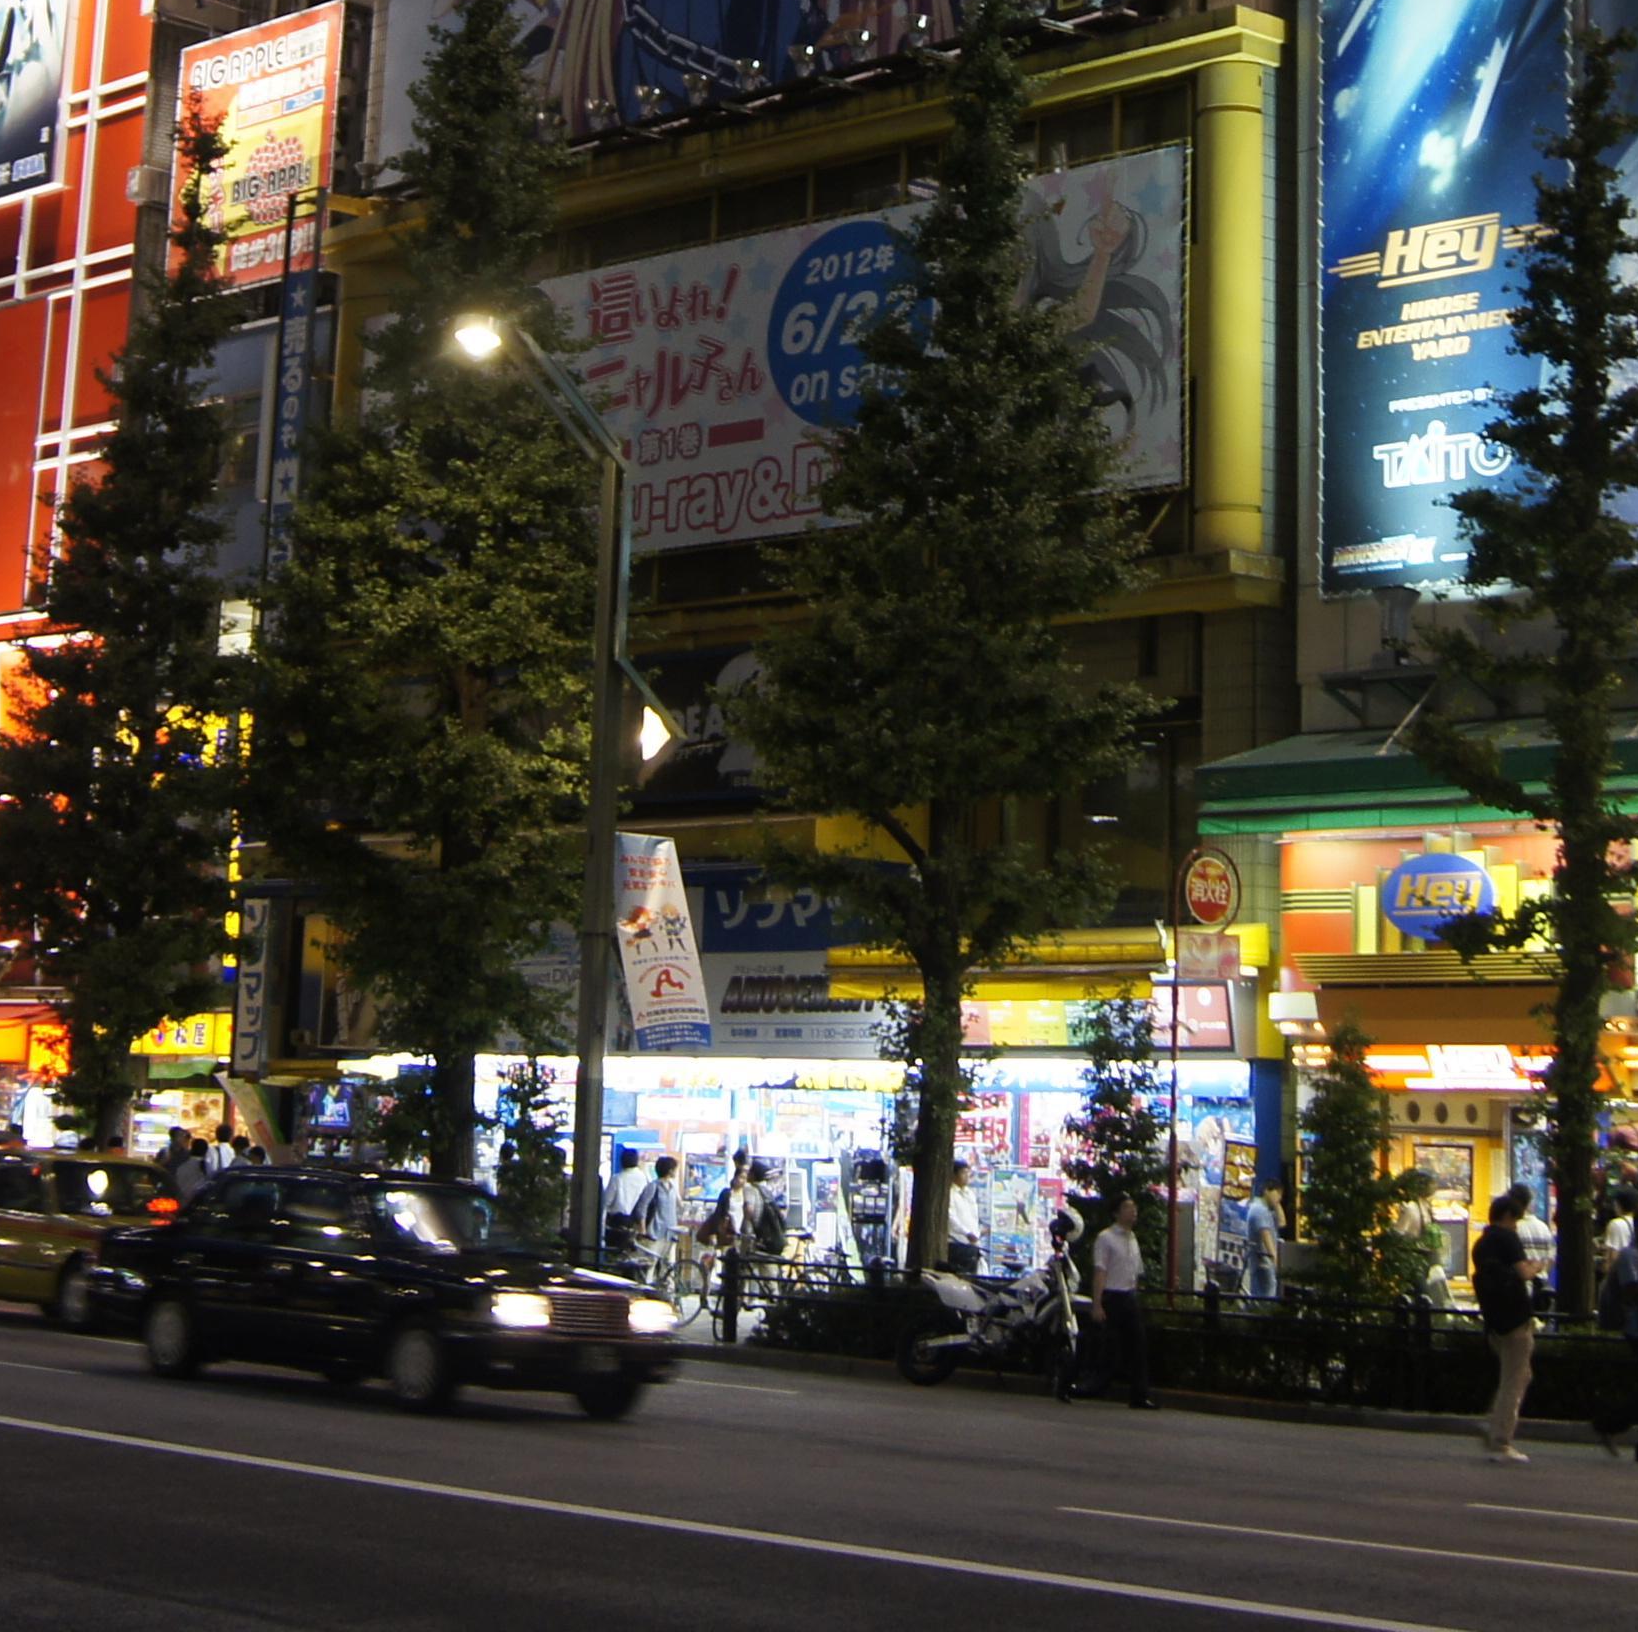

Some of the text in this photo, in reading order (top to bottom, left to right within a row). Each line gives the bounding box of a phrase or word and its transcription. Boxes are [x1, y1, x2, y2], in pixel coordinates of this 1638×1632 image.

[191, 55, 227, 90] BIG
[229, 38, 287, 82] APPLE
[231, 174, 260, 207] BIG
[266, 161, 312, 195] APPLE
[804, 243, 896, 285] 2012年
[1377, 214, 1501, 280] Hey
[1400, 291, 1481, 320] HIROSE
[1356, 307, 1514, 350] ENTERTAINMEN
[1410, 335, 1470, 361] YARD
[789, 370, 830, 406] on
[1190, 878, 1229, 906] 消火栓
[1393, 872, 1482, 912] Hey
